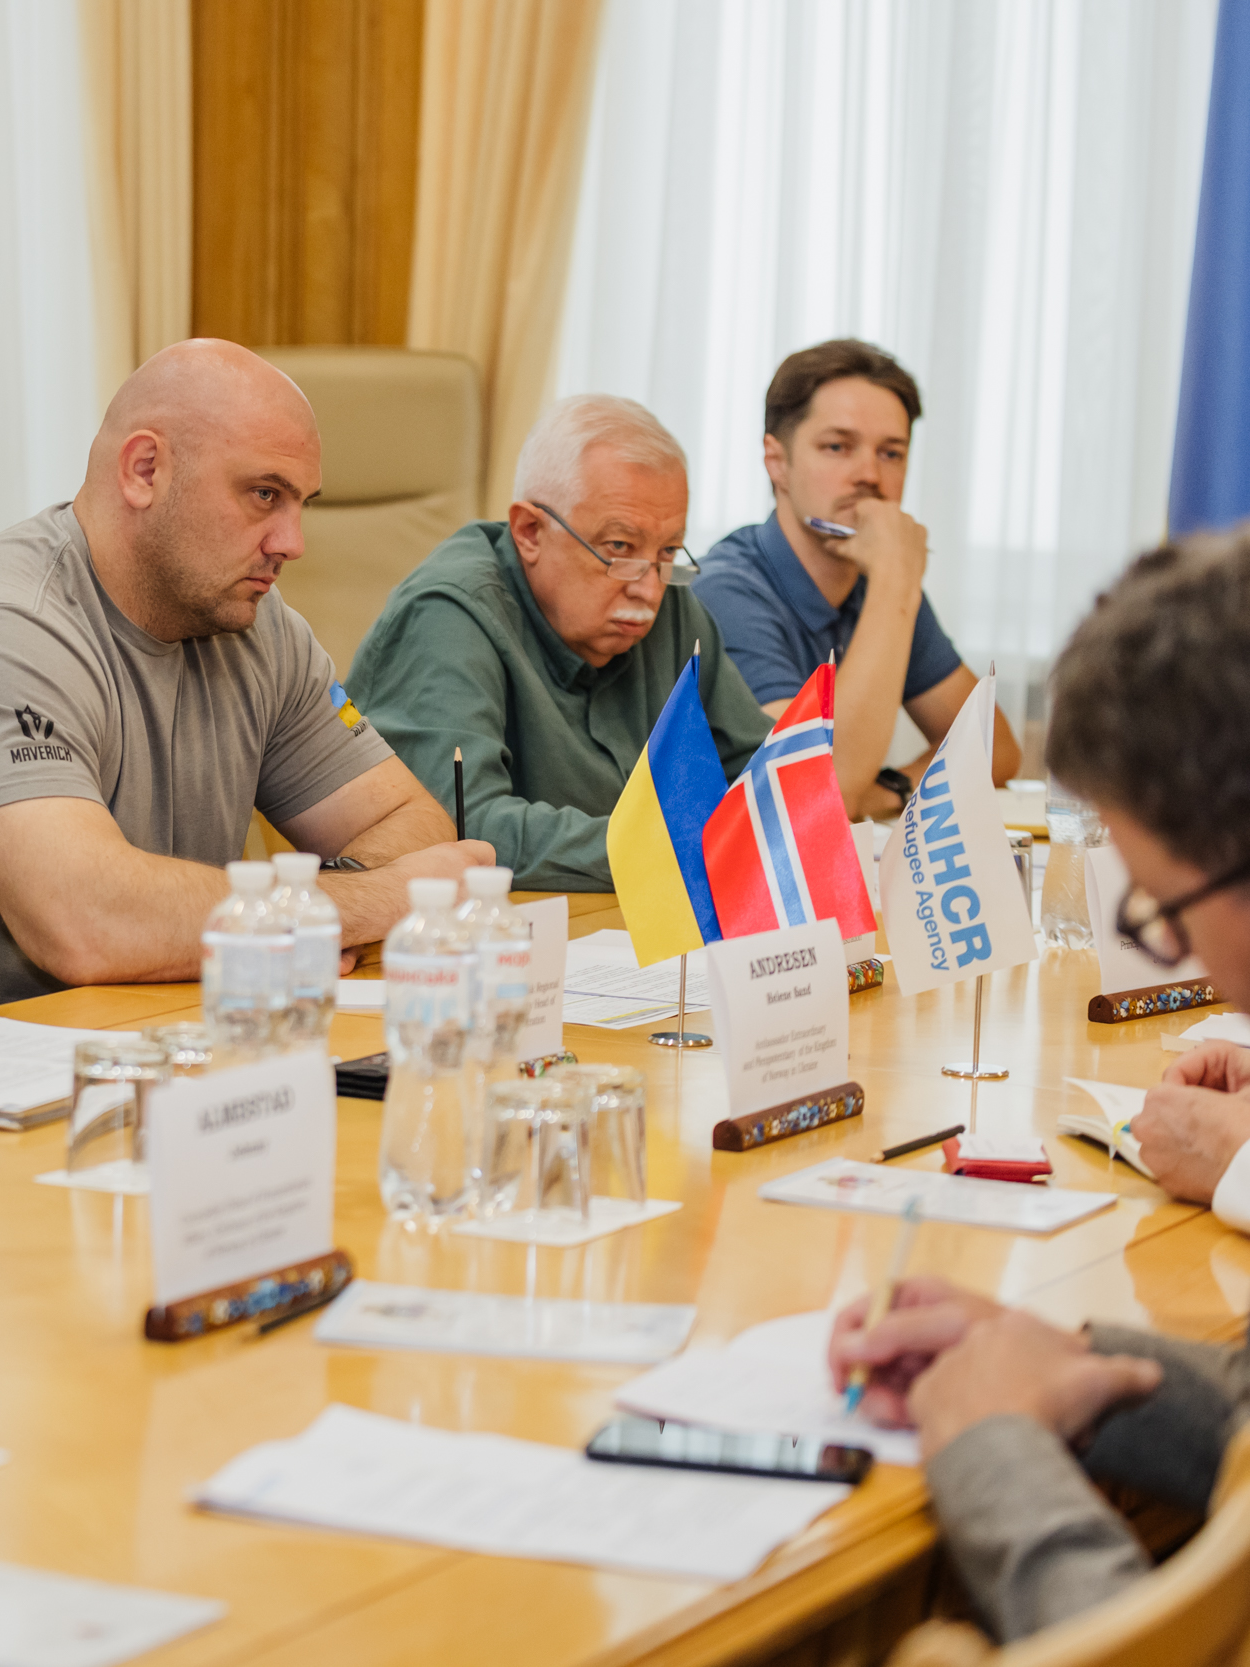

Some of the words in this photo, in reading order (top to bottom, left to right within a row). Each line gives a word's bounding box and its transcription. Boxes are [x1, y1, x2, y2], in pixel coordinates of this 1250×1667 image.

[10, 745, 73, 764] MAVERICK
[903, 792, 926, 884] Refugee
[915, 890, 950, 971] Agency
[918, 758, 993, 969] UNHCR
[749, 946, 818, 980] ANDRESEN
